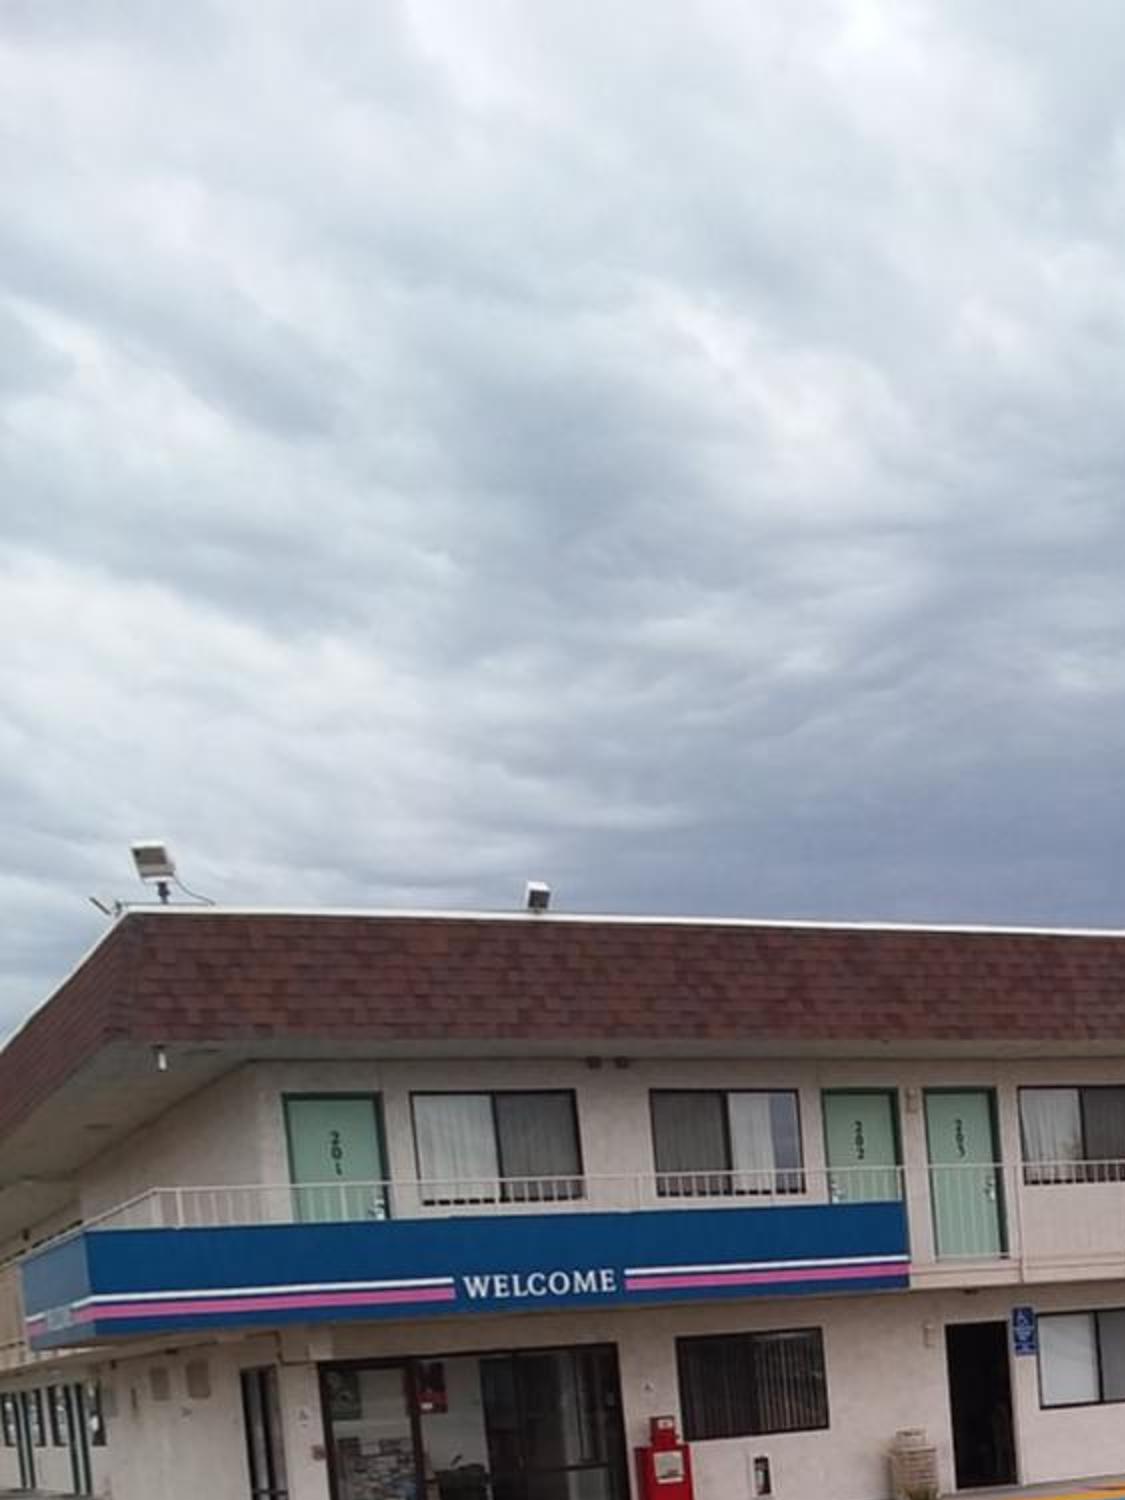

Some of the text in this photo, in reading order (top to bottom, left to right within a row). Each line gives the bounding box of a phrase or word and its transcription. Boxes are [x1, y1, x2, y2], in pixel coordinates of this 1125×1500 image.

[329, 1130, 343, 1176] 201
[854, 1119, 865, 1160] 202
[463, 1269, 617, 1299] WELCOME
